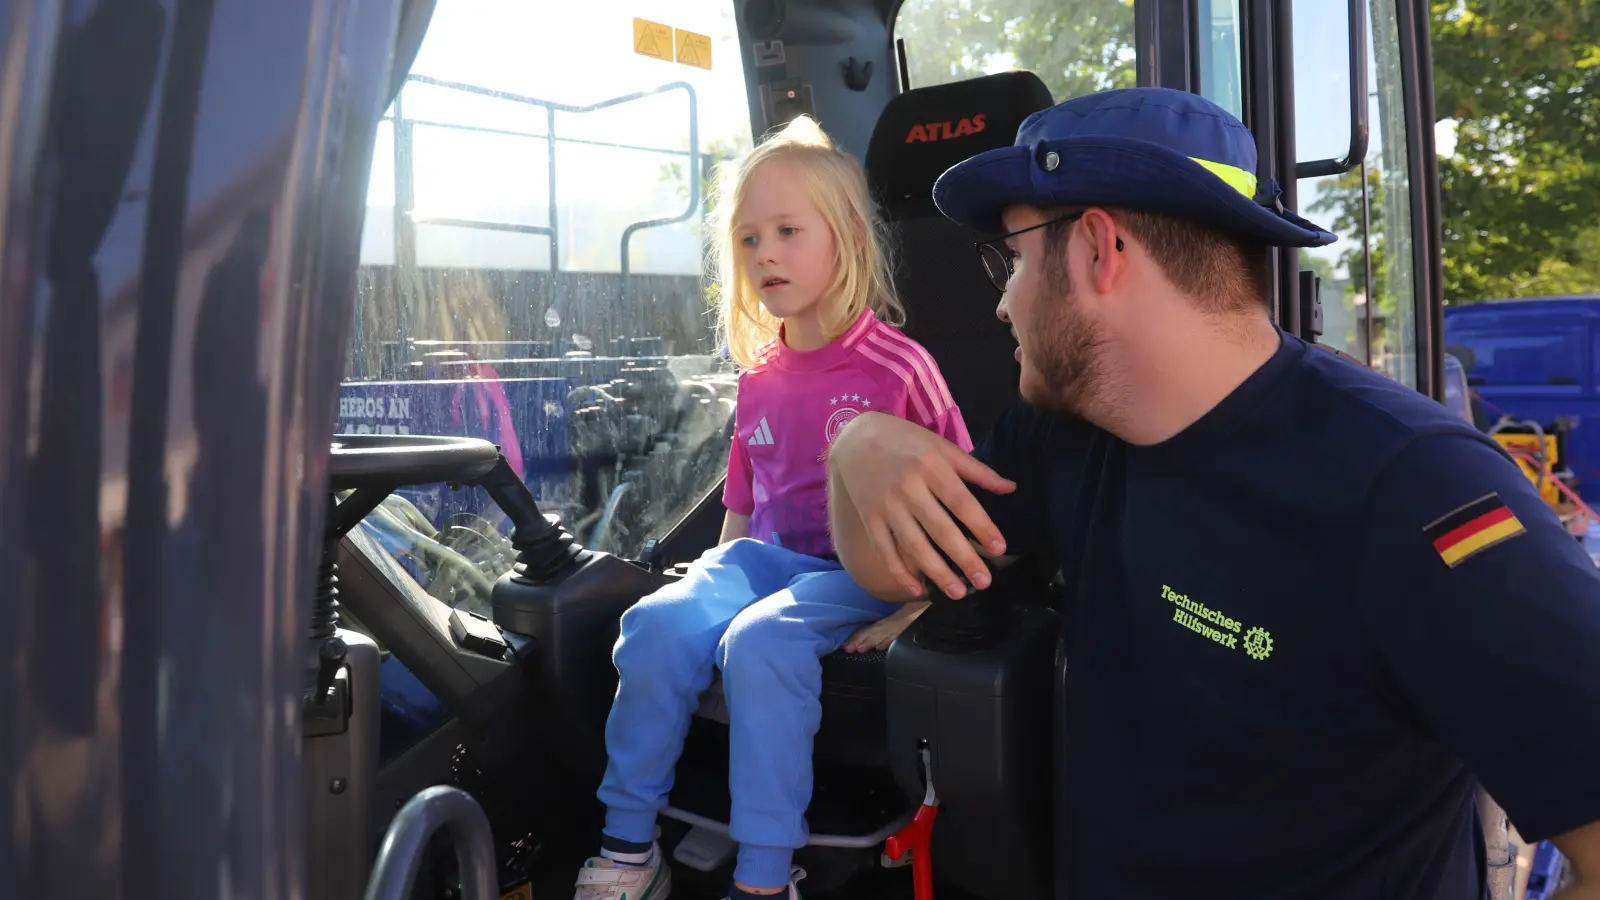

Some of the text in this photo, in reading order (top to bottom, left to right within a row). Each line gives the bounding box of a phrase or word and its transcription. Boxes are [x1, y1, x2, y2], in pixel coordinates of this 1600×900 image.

[905, 112, 986, 144] ATLAS
[340, 397, 409, 419] HEROS AN
[1161, 584, 1242, 633] Technisches
[1173, 608, 1238, 650] Hilfswerk
